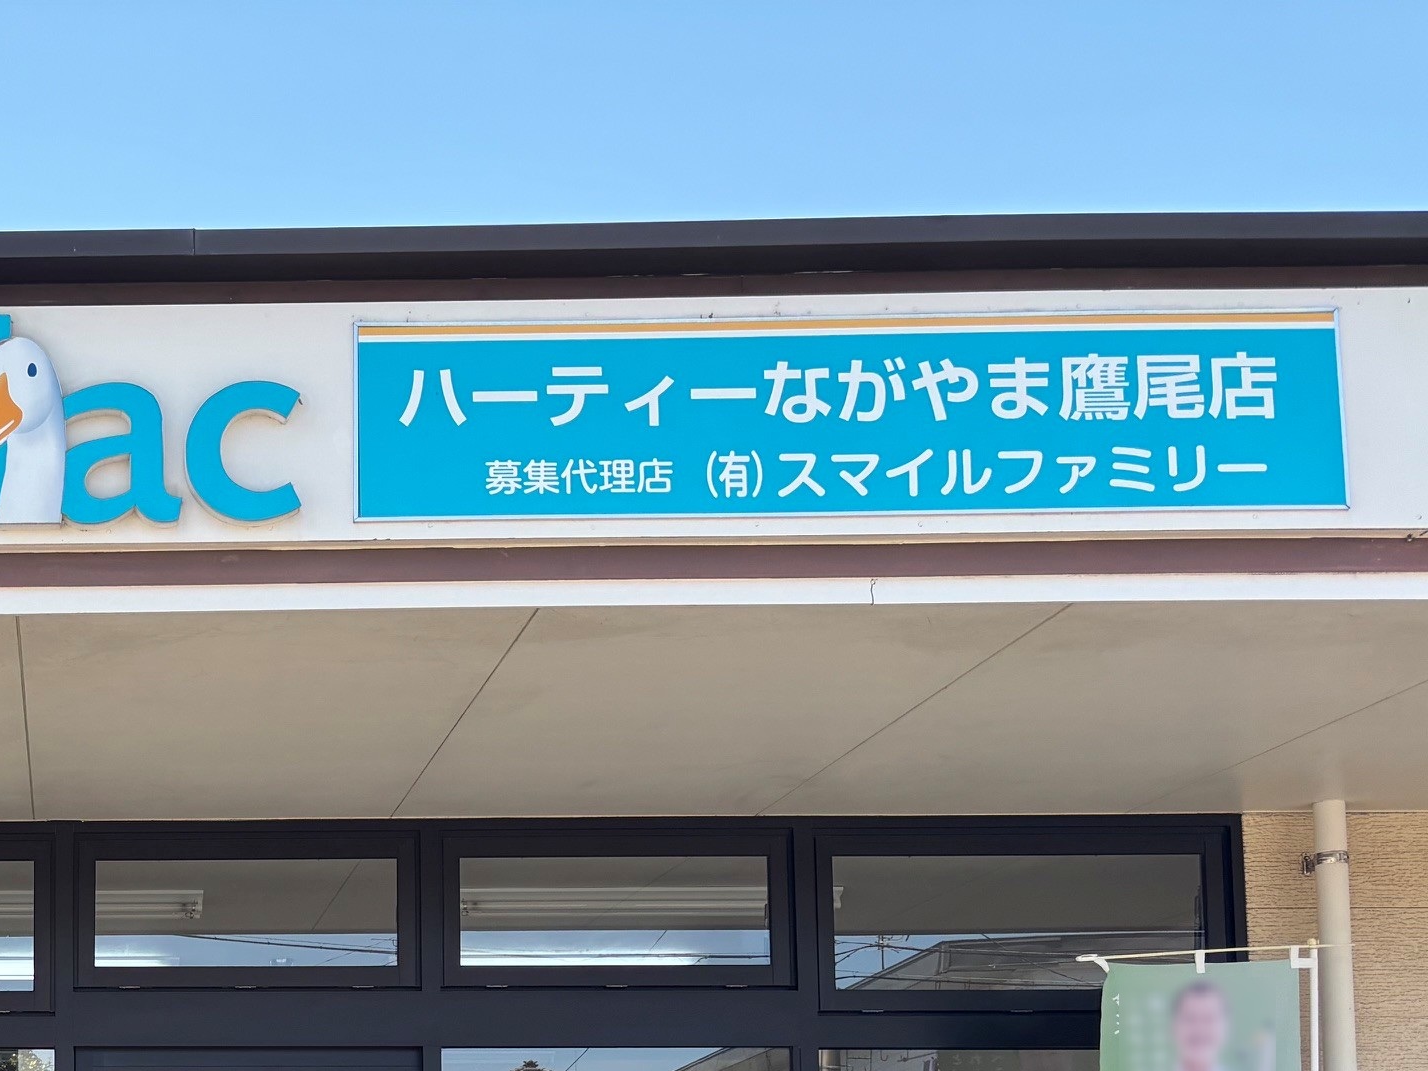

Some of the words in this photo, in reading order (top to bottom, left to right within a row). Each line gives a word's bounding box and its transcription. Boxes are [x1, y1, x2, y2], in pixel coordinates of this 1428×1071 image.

[399, 351, 1279, 429] ハーティーながやま鷹尾店
[484, 458, 674, 497] 募集代理店
